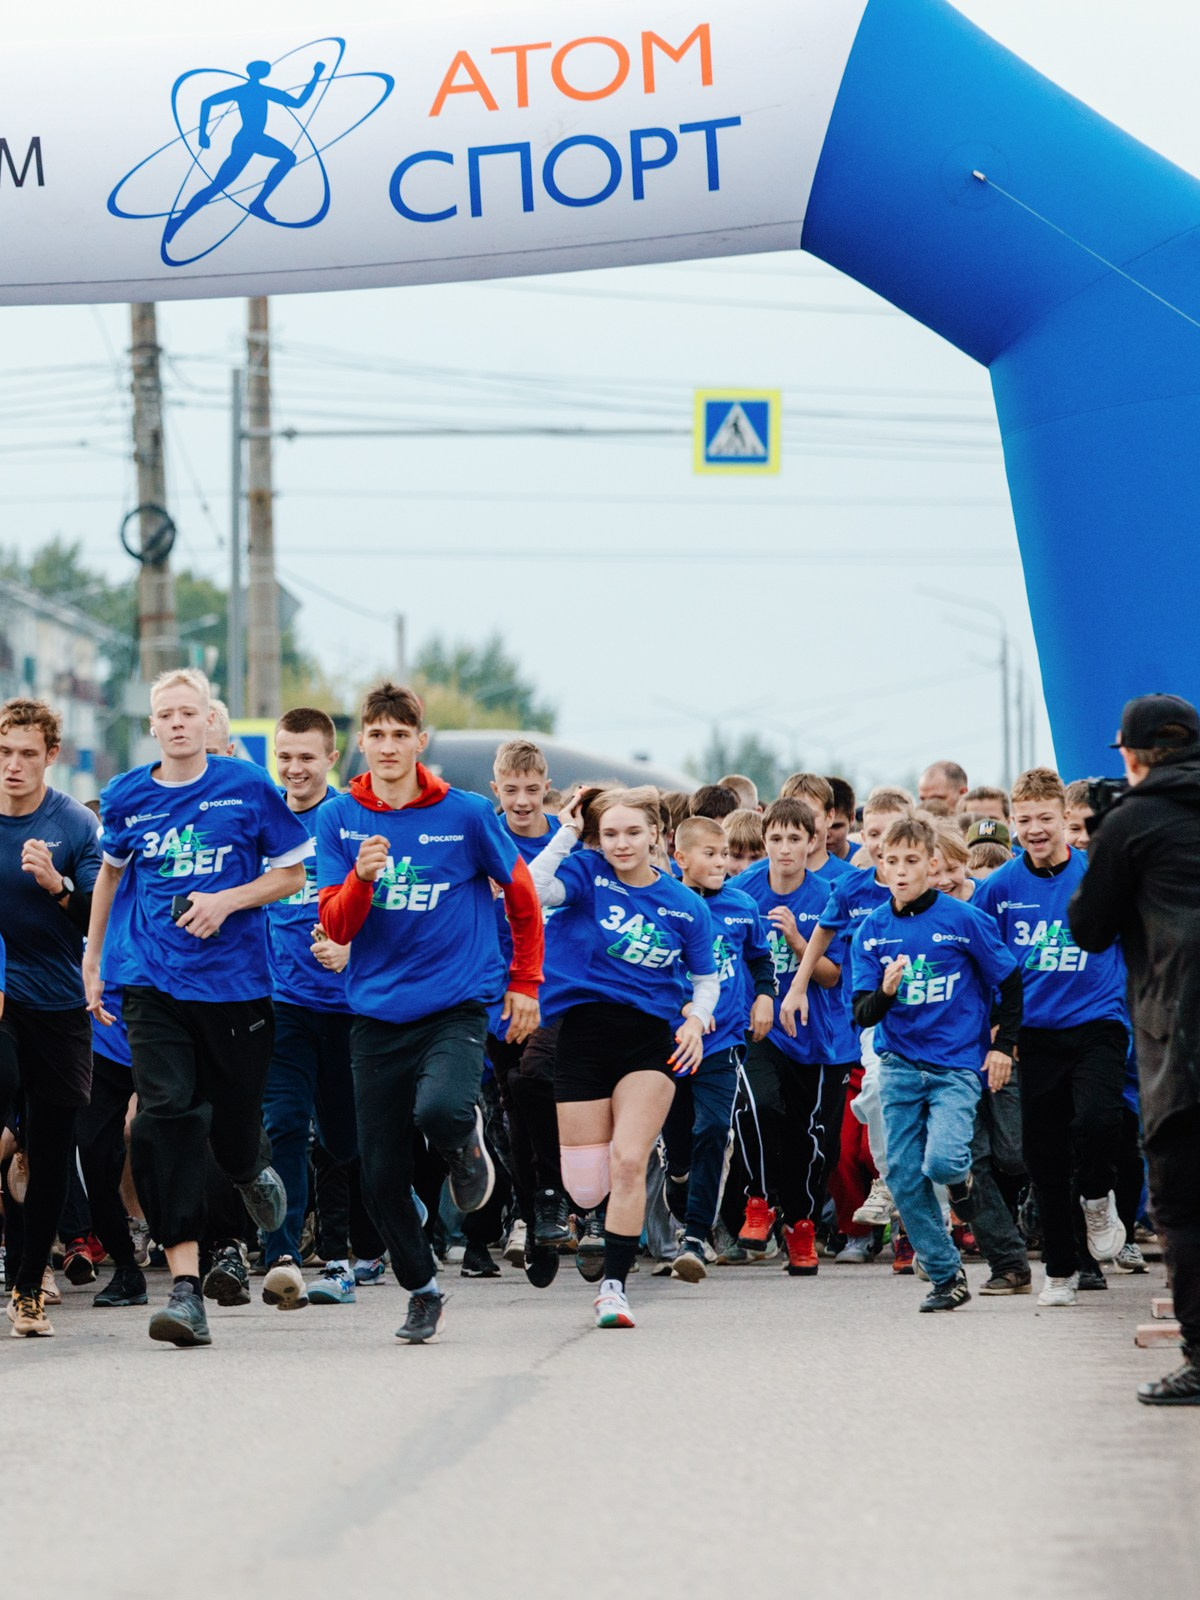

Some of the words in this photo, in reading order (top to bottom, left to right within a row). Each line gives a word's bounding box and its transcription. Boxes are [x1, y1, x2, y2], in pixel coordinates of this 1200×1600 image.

[428, 23, 713, 117] АТОМ
[389, 116, 741, 223] СПОРТ
[209, 799, 243, 808] РОСАТОМ
[143, 824, 194, 858] ЗА!
[429, 834, 464, 843] РОСАТОМ
[173, 845, 232, 877] БЕГ
[386, 882, 450, 911] БЕГ
[600, 905, 655, 942] ЗА!
[1014, 920, 1062, 946] ЗА!
[623, 941, 682, 968] БЕГ
[905, 972, 960, 1005] БЕГ
